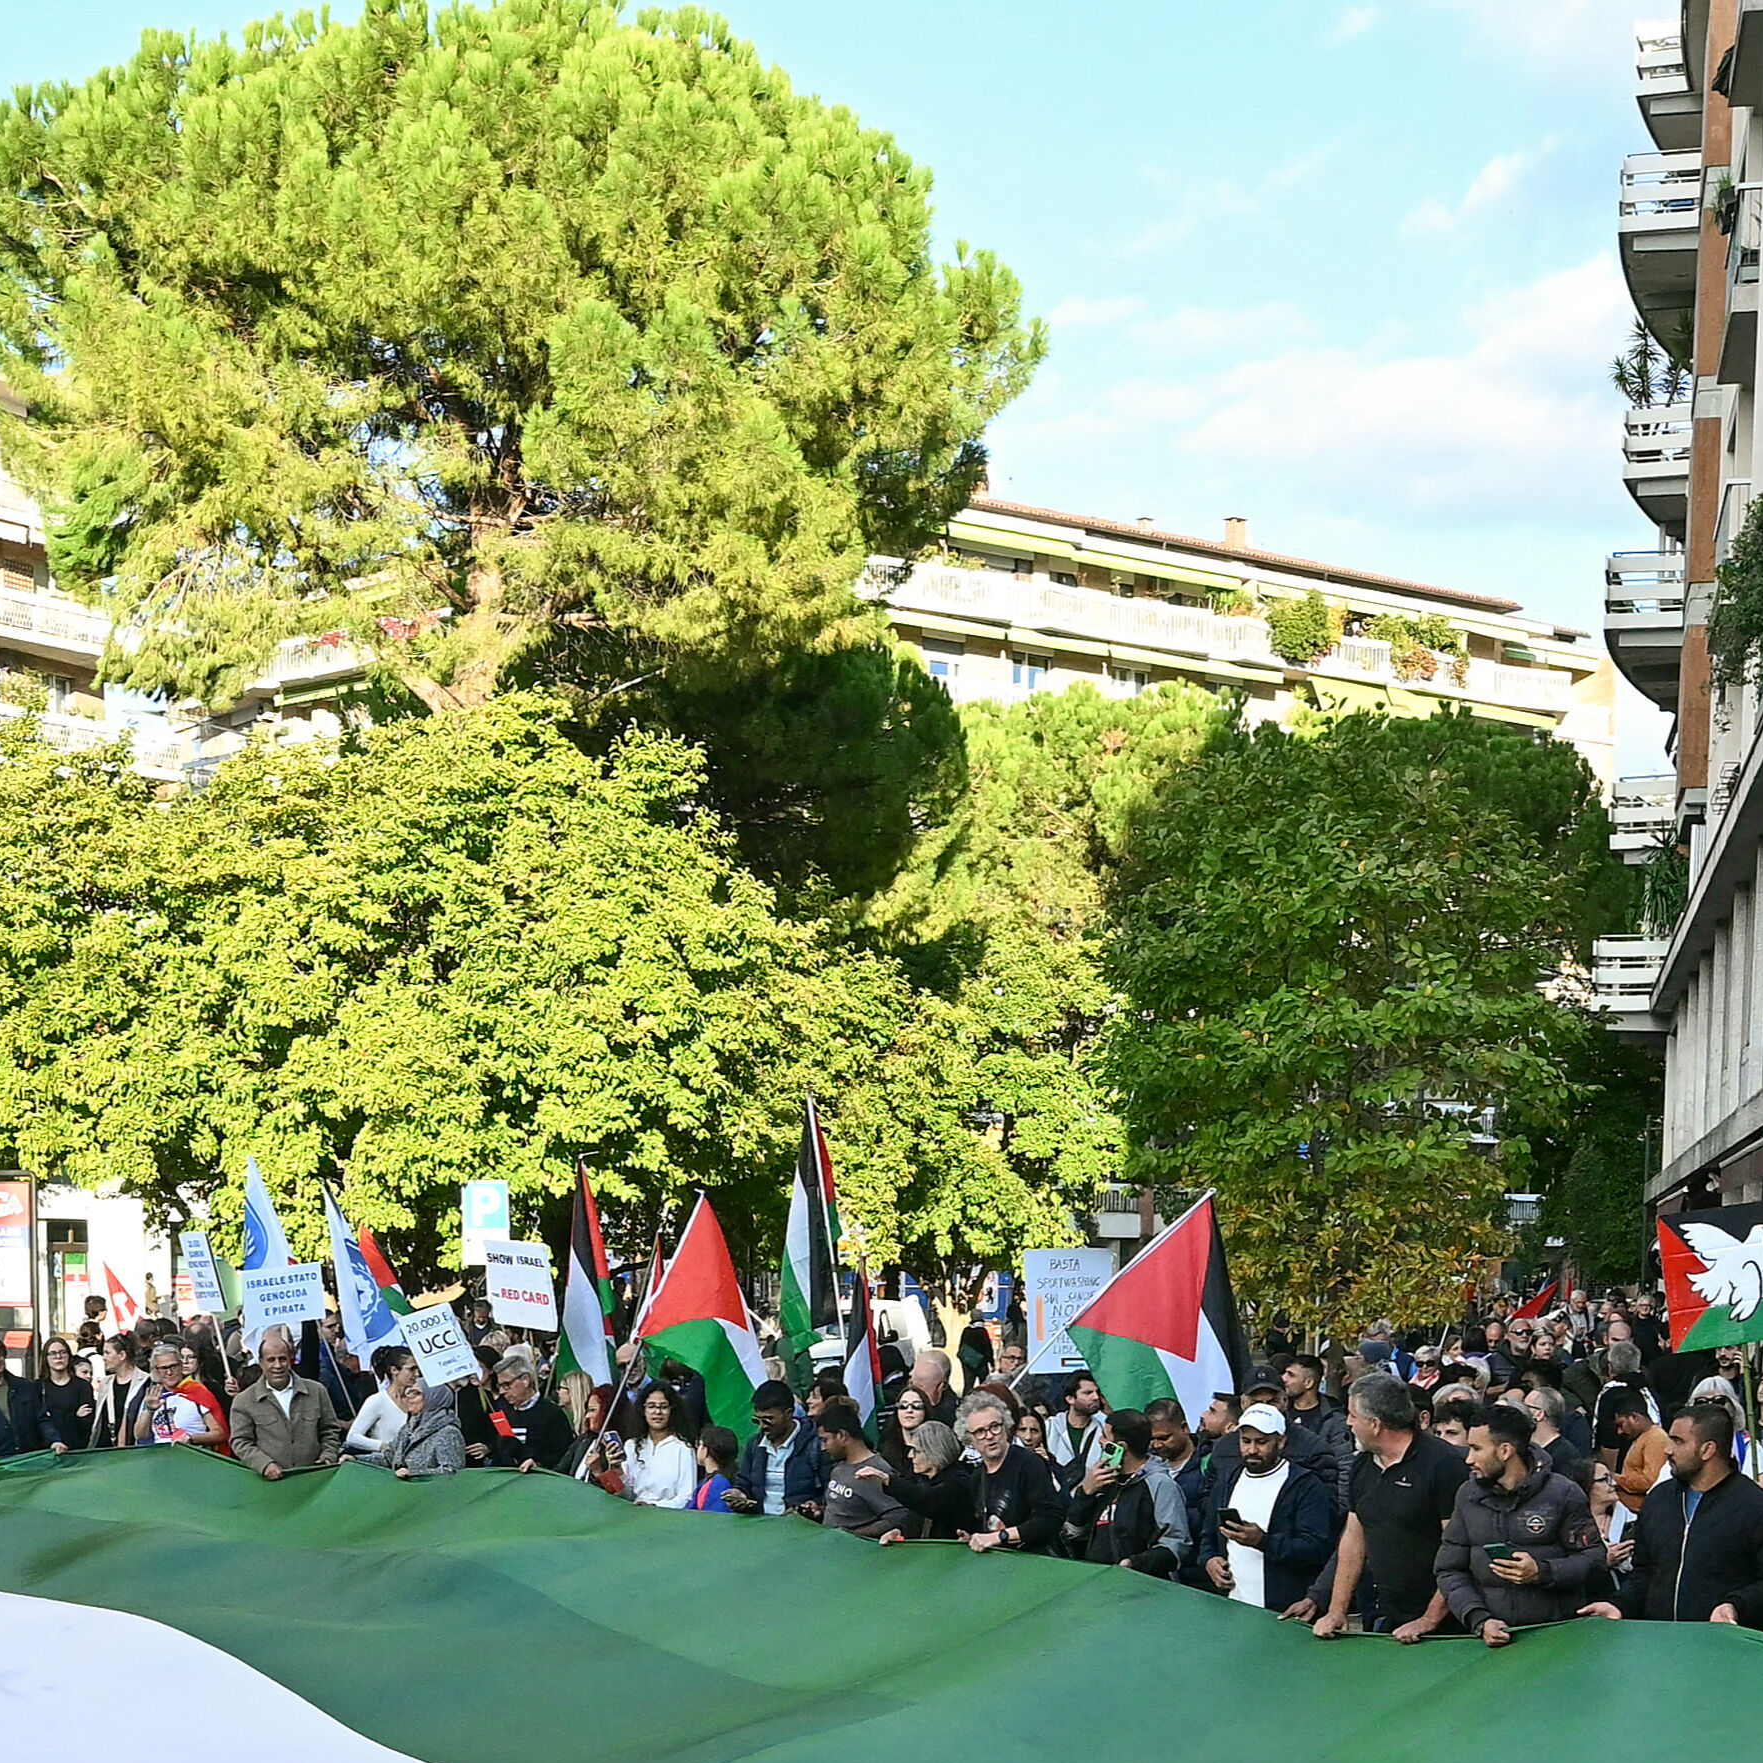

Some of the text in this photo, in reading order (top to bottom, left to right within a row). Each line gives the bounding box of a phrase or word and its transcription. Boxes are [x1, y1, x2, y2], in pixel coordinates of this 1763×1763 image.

[471, 1186, 501, 1226] P
[486, 1252, 545, 1268] SHOW ISRAEL
[1049, 1258, 1080, 1270] BASTA
[246, 1272, 318, 1289] ISRAELE STATO
[259, 1290, 308, 1302] GENOCIDA
[501, 1288, 520, 1300] RED
[521, 1290, 550, 1306] CARD
[264, 1303, 306, 1316] E PIRATA
[405, 1314, 441, 1334] 20.000
